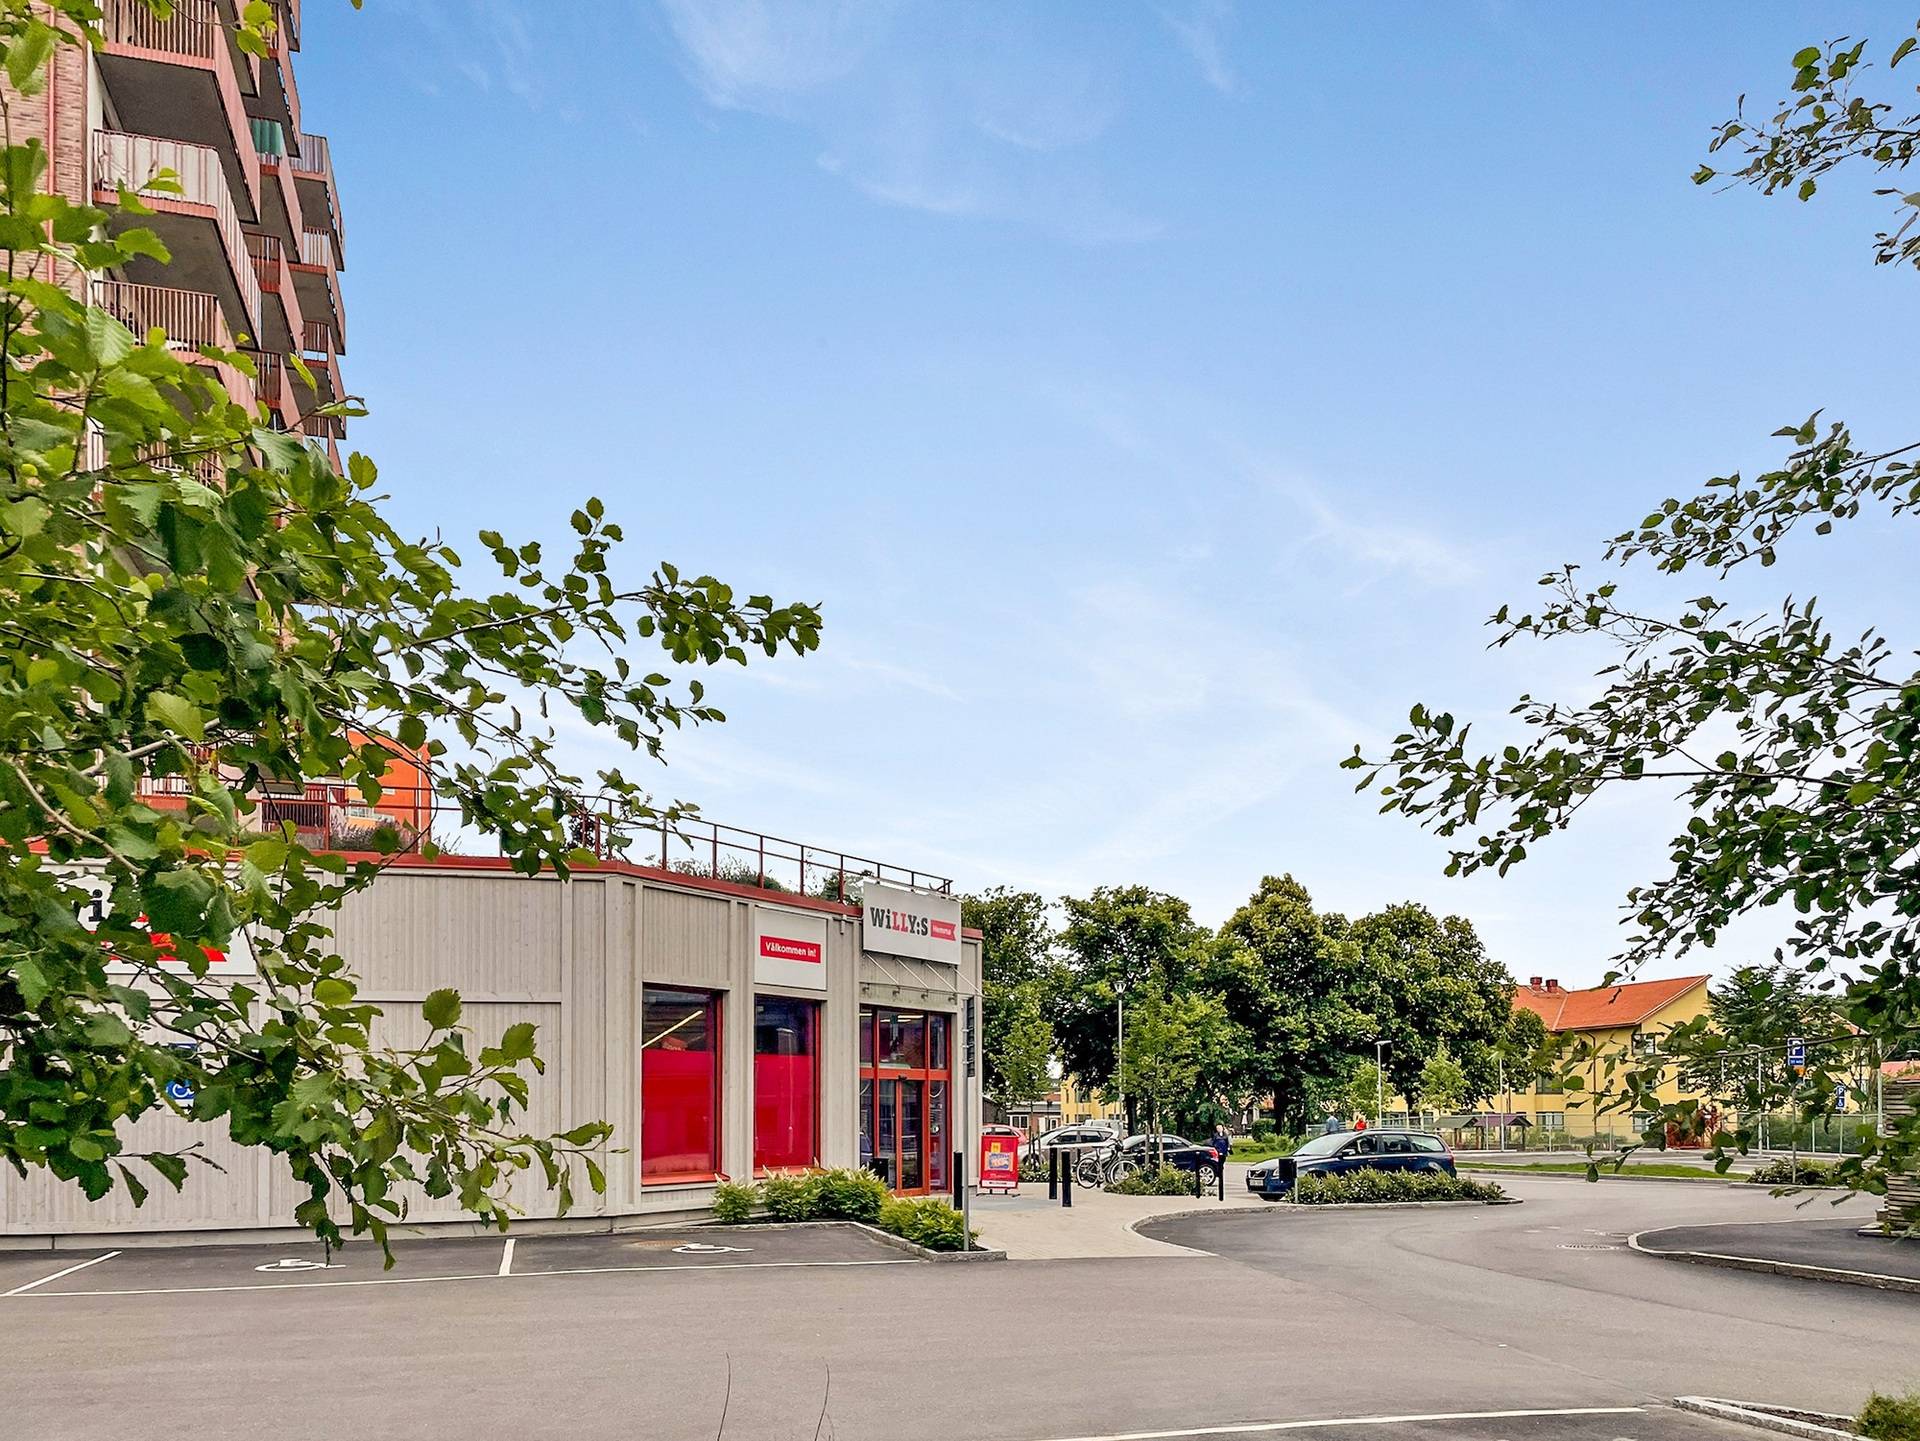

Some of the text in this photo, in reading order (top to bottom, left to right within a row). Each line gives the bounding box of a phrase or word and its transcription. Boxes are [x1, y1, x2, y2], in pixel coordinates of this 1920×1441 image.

[765, 942, 816, 956] Välkommen in!
[1792, 1040, 1802, 1055] P
